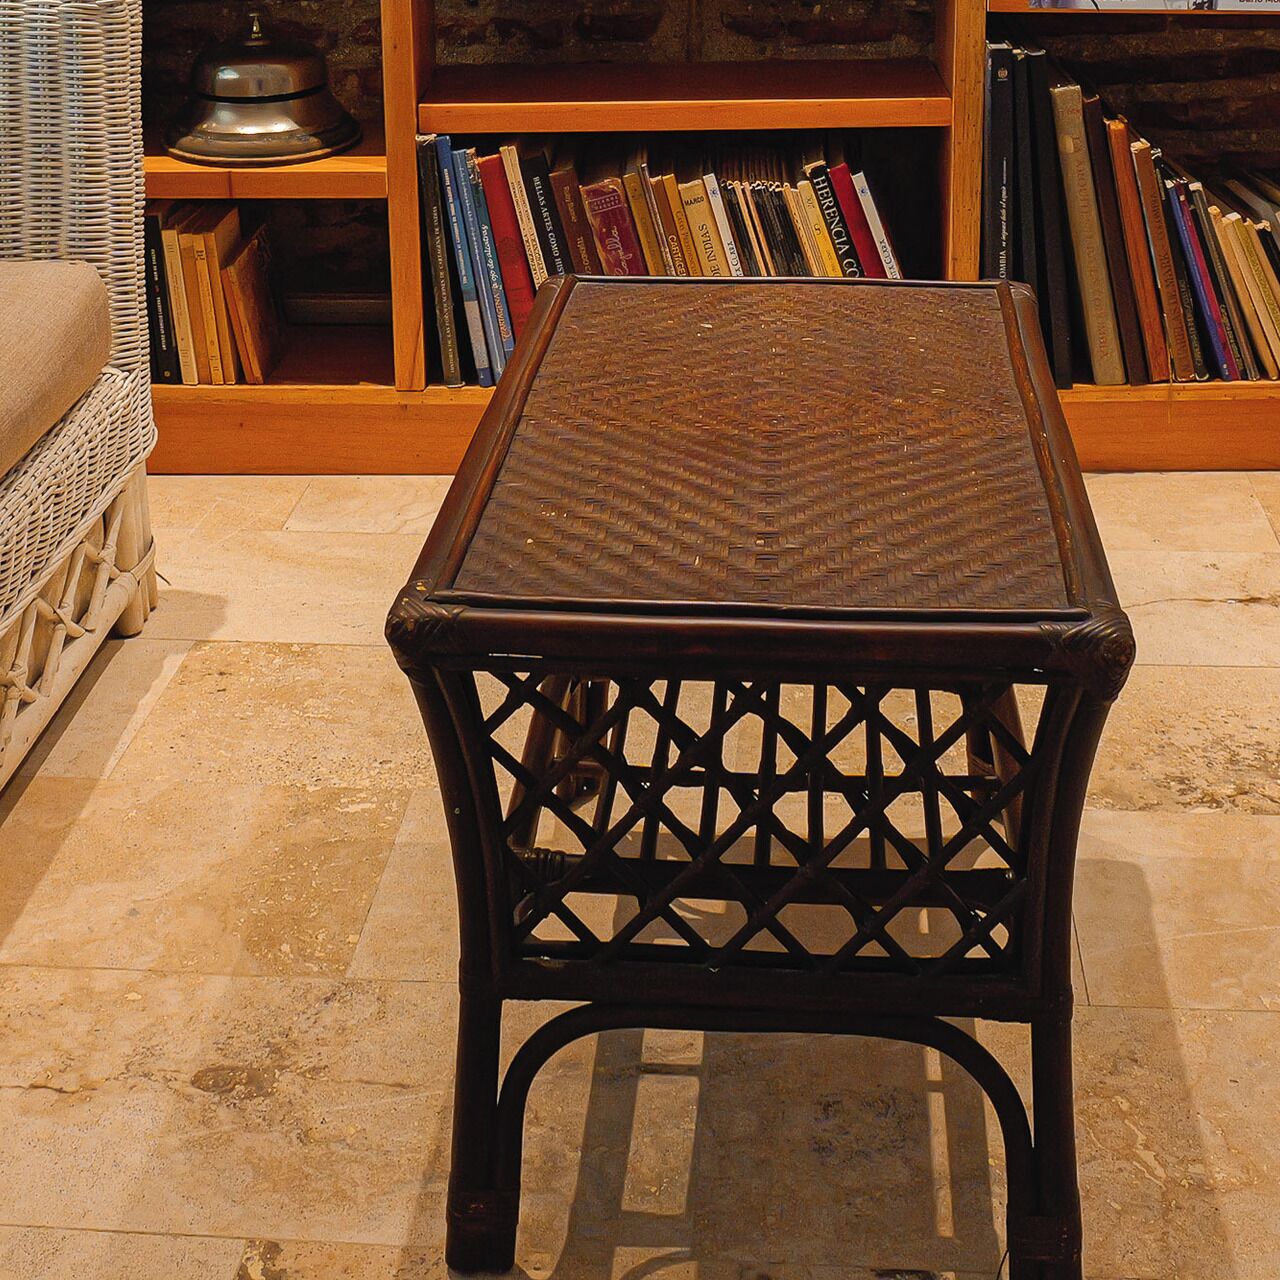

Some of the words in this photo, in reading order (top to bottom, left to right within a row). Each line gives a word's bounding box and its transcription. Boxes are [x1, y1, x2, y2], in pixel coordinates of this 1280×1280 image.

[532, 176, 545, 206] BELLAS
[539, 207, 552, 232] ARTES
[546, 232, 557, 256] COMO
[699, 223, 715, 260] INDIAS
[812, 176, 850, 257] HERENCIA
[999, 250, 1007, 280] OMBIA
